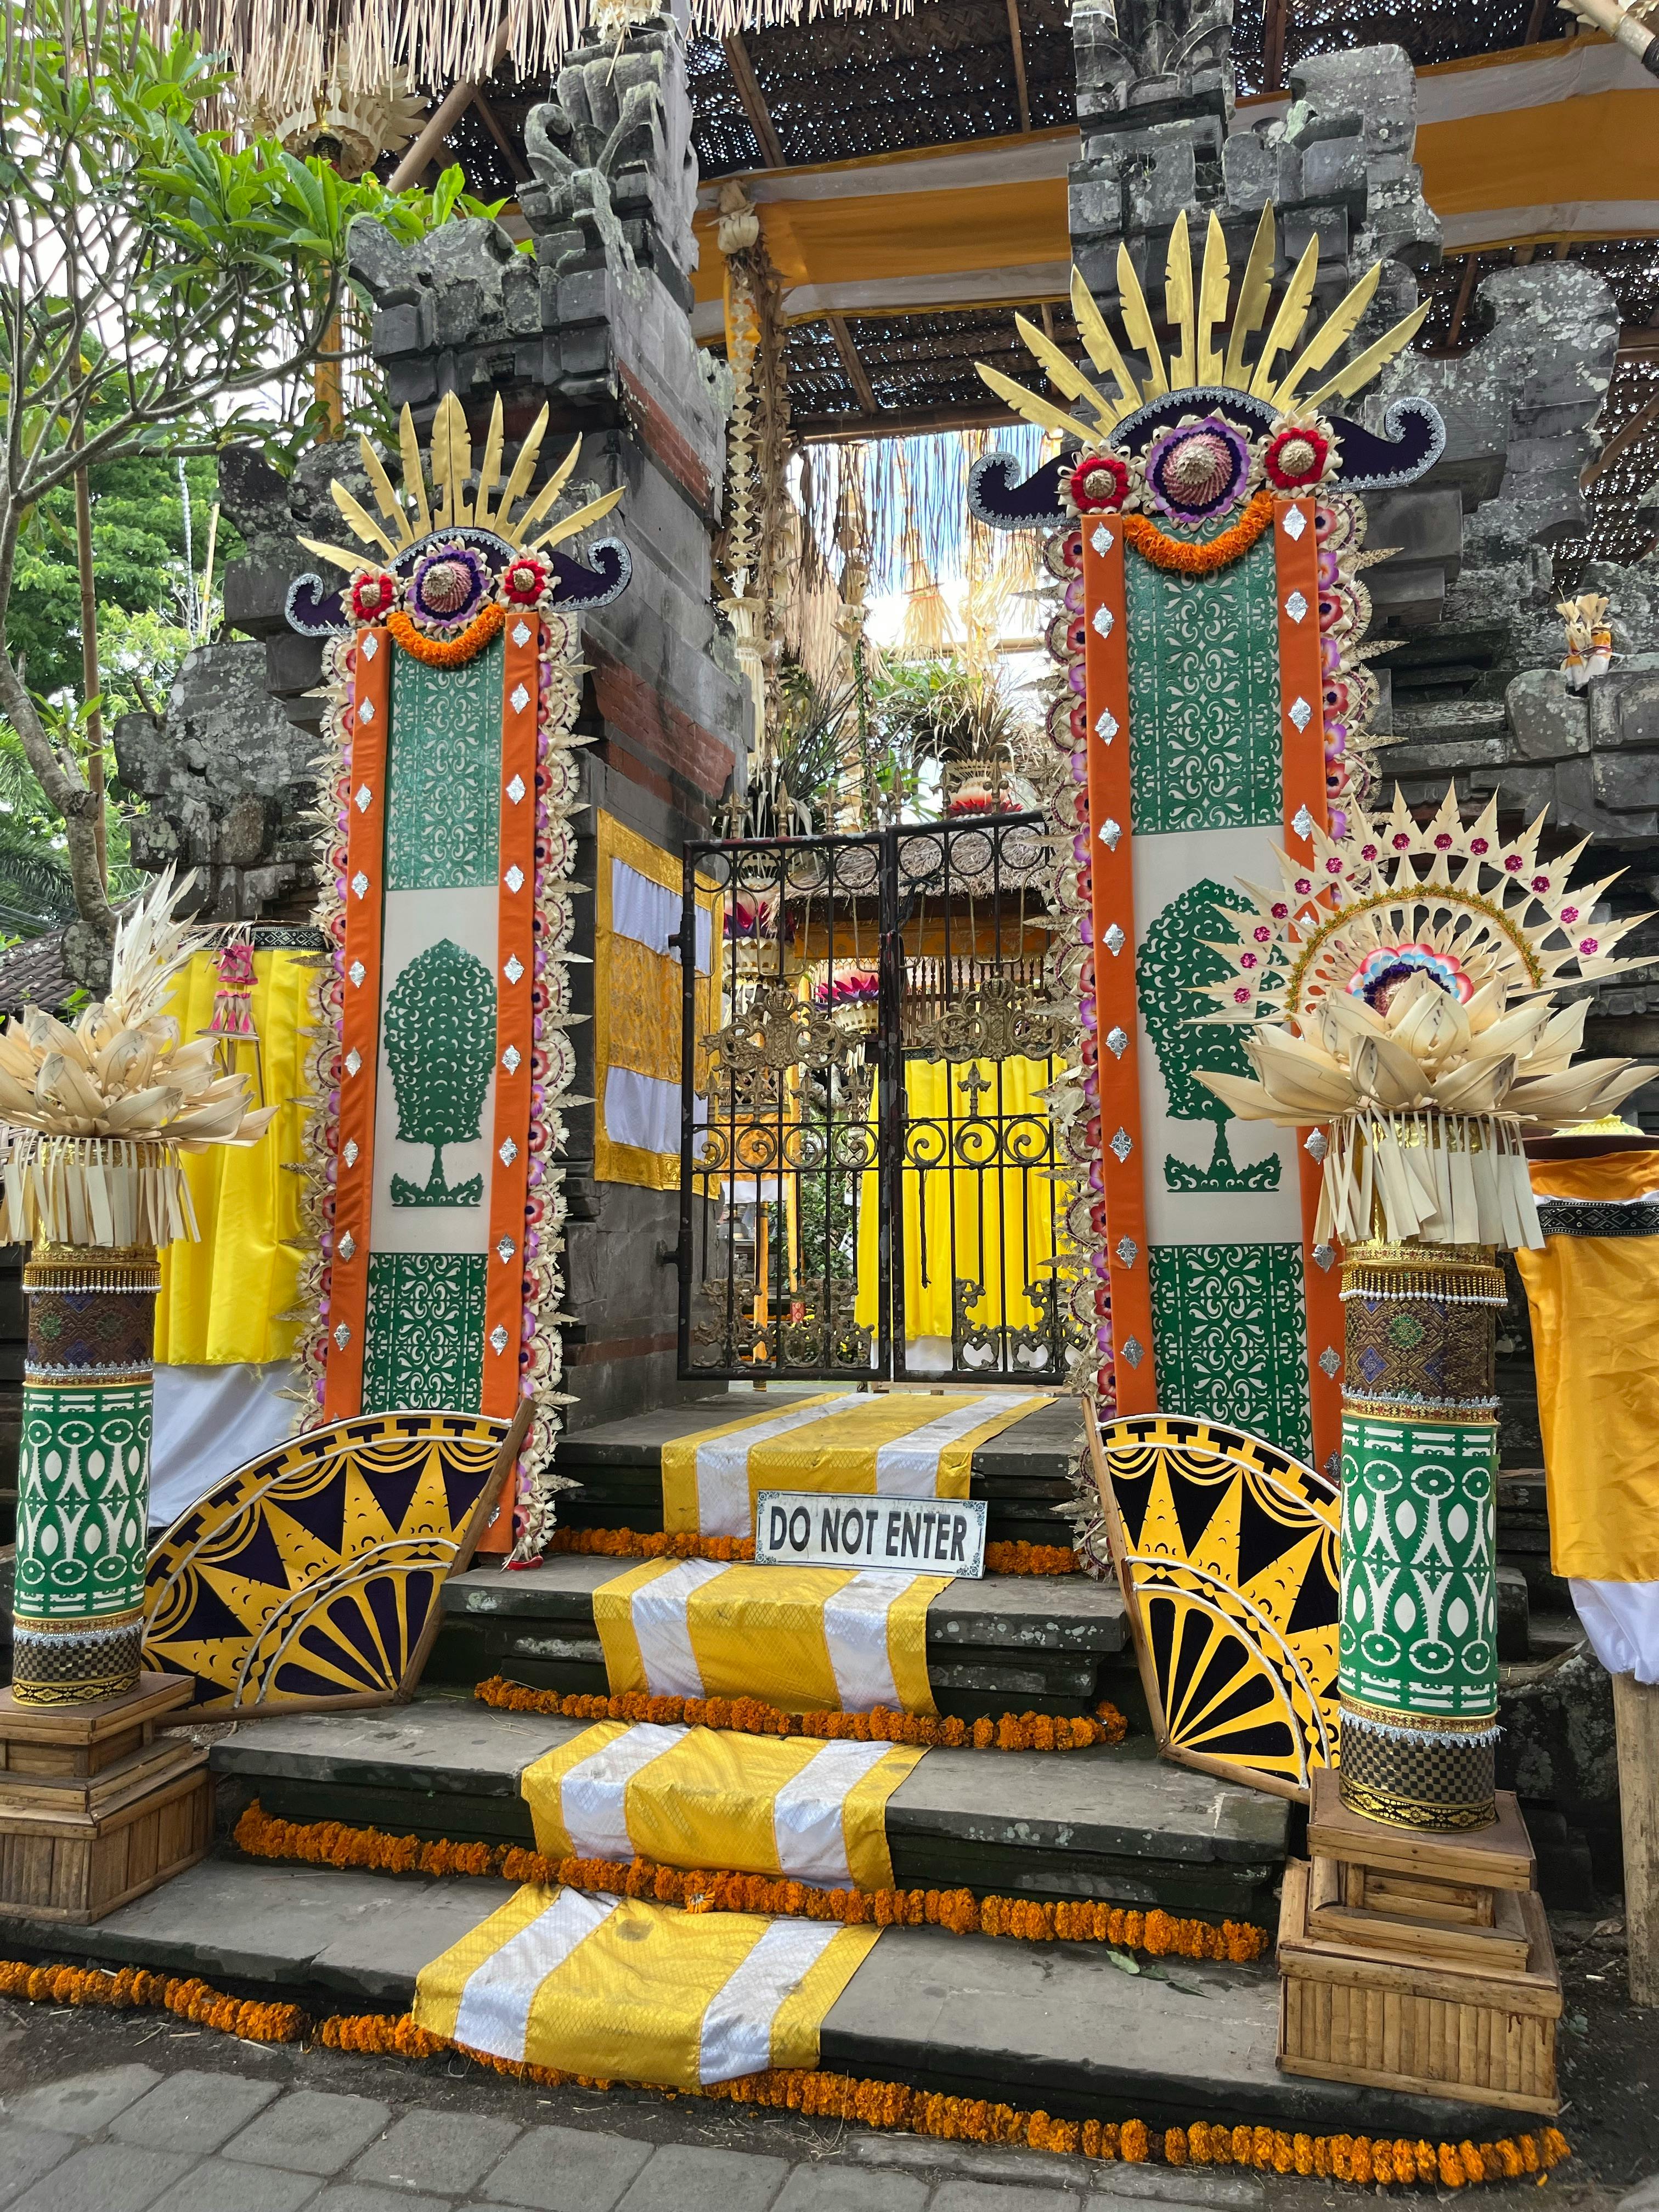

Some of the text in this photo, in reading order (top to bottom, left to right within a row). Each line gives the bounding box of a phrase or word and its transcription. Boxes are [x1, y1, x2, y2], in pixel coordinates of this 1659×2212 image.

[769, 1506, 967, 1561] DO NOT ENTER
